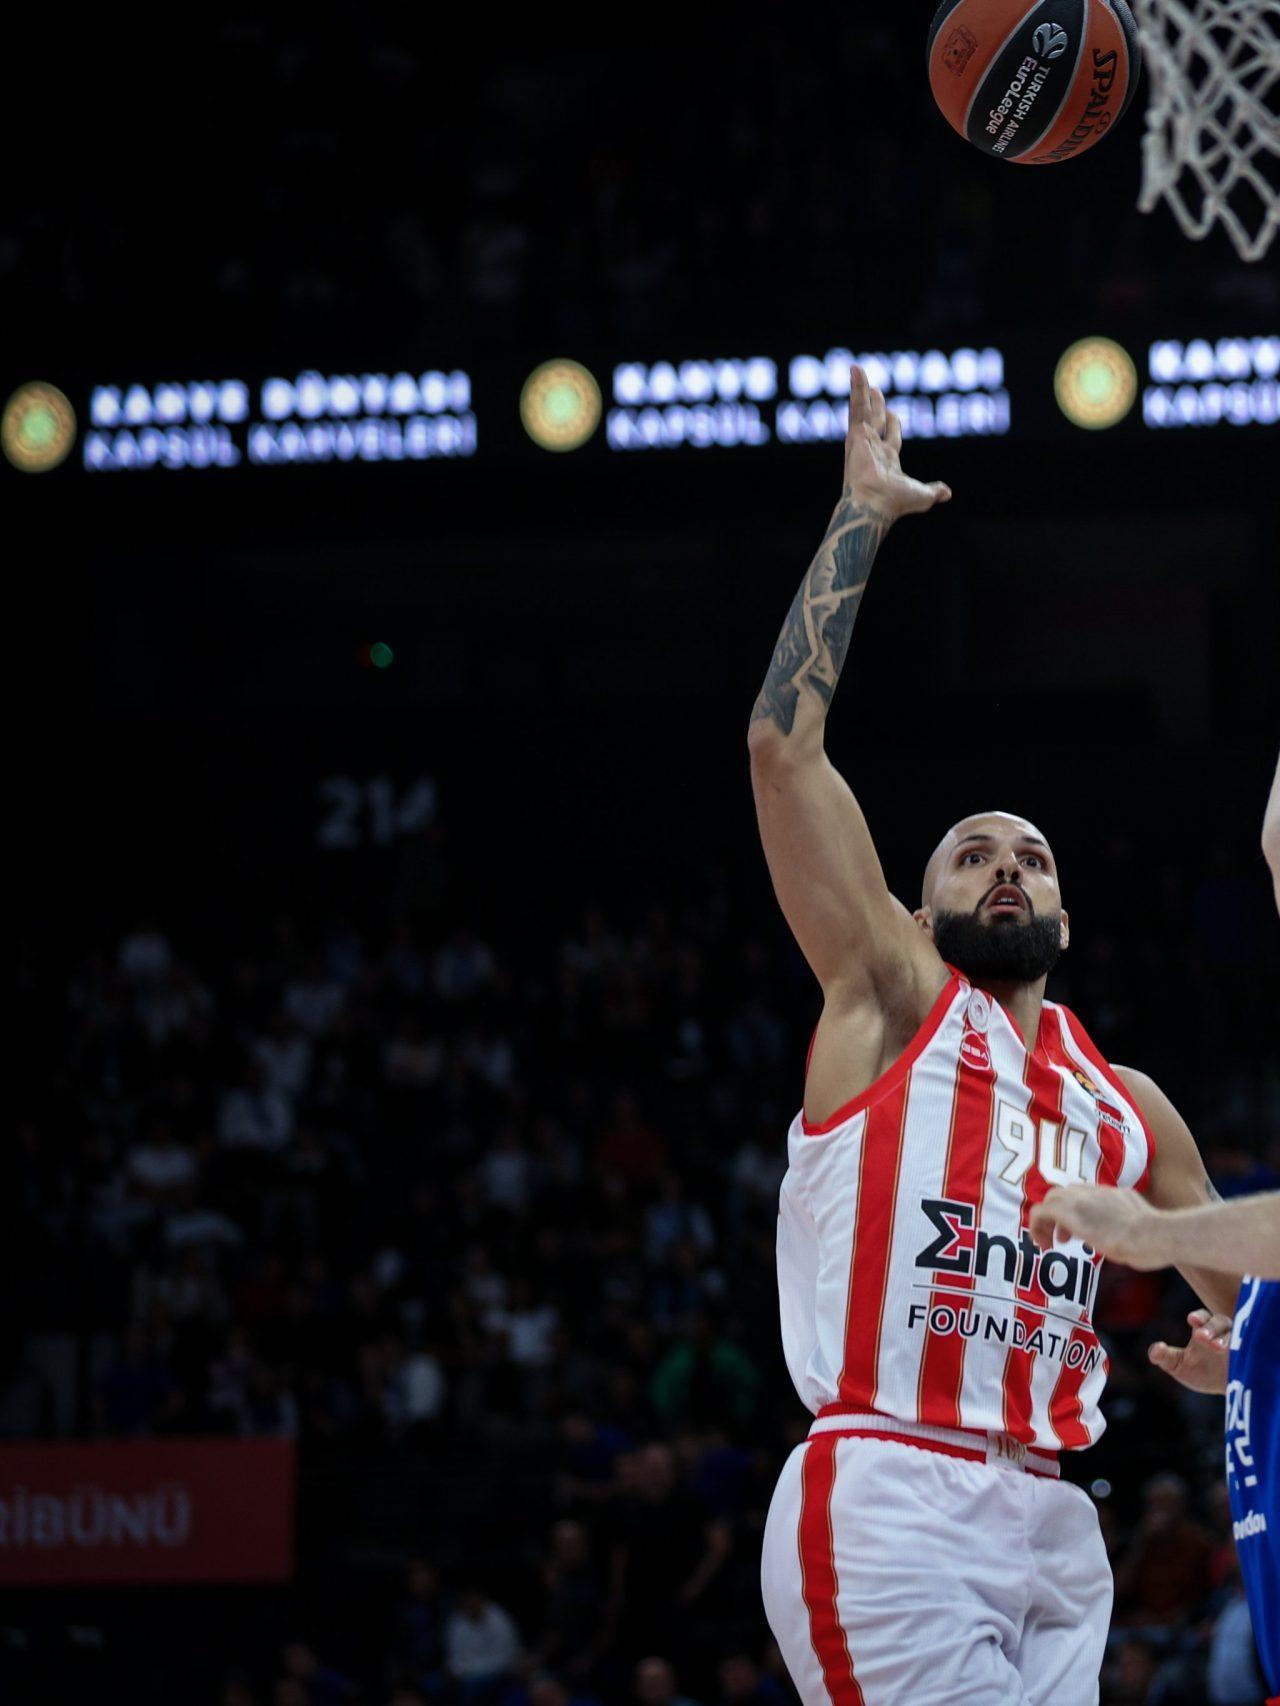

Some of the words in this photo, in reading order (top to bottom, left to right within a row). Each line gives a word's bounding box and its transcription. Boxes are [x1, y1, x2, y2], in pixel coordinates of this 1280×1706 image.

[985, 56, 1038, 135] EuroLeague
[1013, 65, 1050, 121] TURKISH
[991, 118, 1020, 154] AIRLINES
[82, 420, 242, 474] KAPSÜL
[606, 398, 770, 450] KAPSÜL
[907, 1304, 1102, 1373] FOUNDATION
